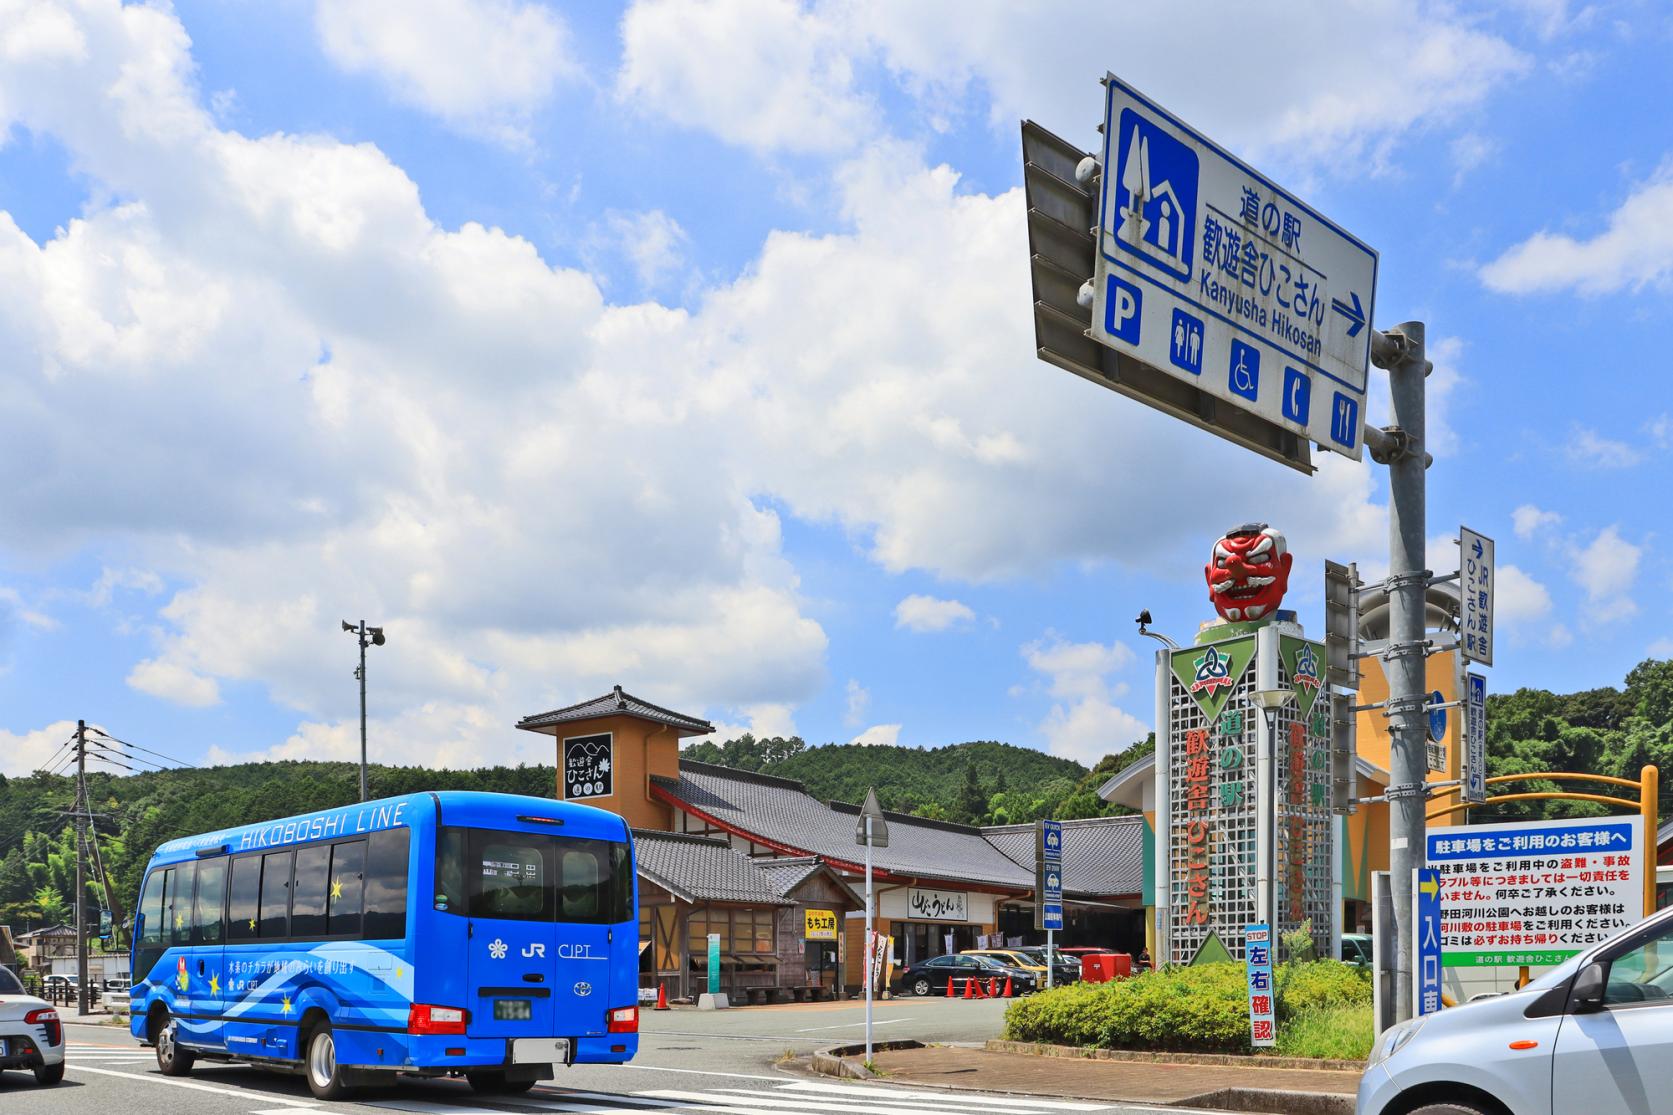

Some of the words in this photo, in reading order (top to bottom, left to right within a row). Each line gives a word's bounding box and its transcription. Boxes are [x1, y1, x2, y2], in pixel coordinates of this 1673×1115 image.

[1239, 185, 1301, 254] 道の駅
[1203, 214, 1325, 327] 歓遊舎ひこさん
[1200, 268, 1267, 328] Kanyusha
[1271, 309, 1321, 357] Hikosan
[566, 765, 605, 784] ひこさん
[1220, 710, 1245, 806] 道の駅
[240, 813, 348, 849] HIKOBOSHI
[356, 802, 408, 832] LINE
[1185, 730, 1210, 925] 歓遊舎ひこさん
[1435, 831, 1627, 854] 駐車場をご利用のお客様へ
[1440, 870, 1630, 888] ラブル等につきましては一切責任を
[1440, 886, 1616, 902] いません。何卒ご了承ください。
[807, 917, 835, 930] もち工房
[1247, 931, 1267, 940] STOP
[522, 943, 545, 957] JR
[1250, 946, 1273, 1040] 左右確認
